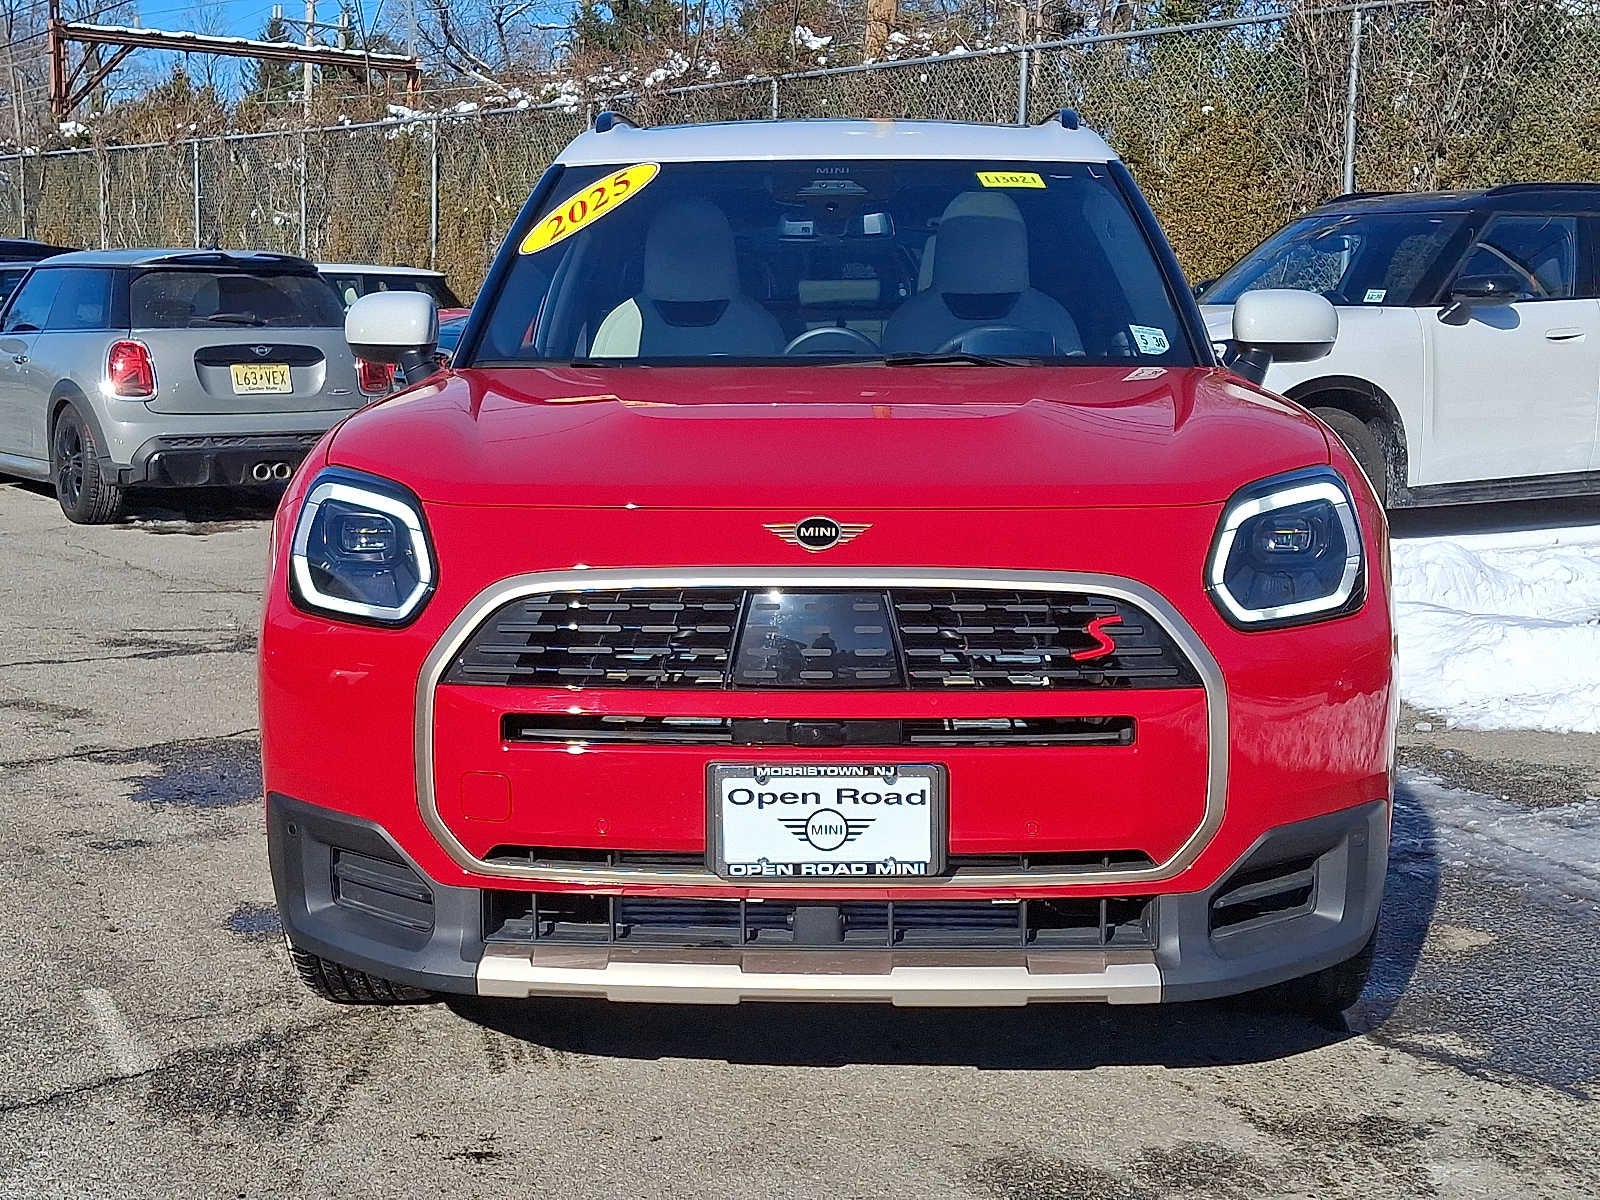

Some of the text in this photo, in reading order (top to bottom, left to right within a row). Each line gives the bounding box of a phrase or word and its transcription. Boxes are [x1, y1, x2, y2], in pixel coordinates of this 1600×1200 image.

[984, 175, 1037, 184] L13021
[547, 172, 631, 241] 2025
[1140, 334, 1166, 348] 5 30
[800, 527, 836, 537] MINI
[1070, 614, 1123, 661] S
[756, 766, 895, 776] MORRISTOWN, NJ
[728, 788, 927, 809] Open Road
[811, 825, 843, 836] MINI
[729, 863, 926, 876] OPEN ROAD MINI
